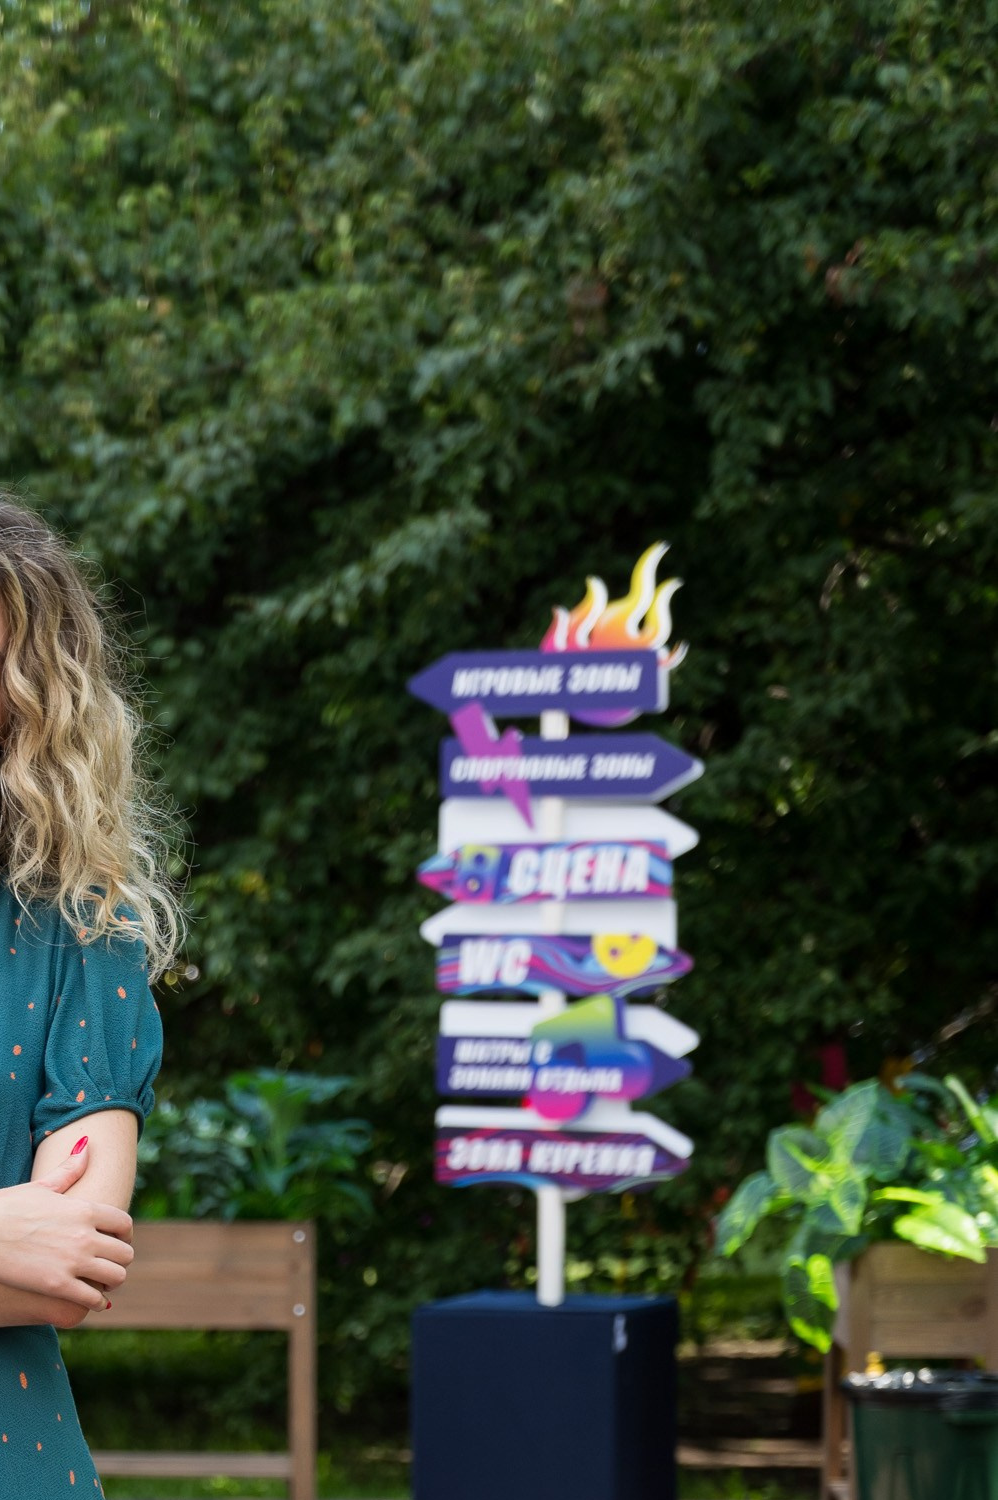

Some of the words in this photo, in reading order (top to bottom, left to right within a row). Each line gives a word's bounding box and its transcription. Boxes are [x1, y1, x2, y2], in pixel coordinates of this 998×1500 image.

[452, 666, 564, 697] ИГРОВЫЕ
[566, 662, 643, 693] ЗОНЫ
[449, 756, 588, 782] СПОРТИВНЫЕ
[589, 753, 656, 780] ЗОНЫ
[508, 845, 650, 900] СЦЕНА
[458, 938, 532, 986] WC
[448, 1065, 534, 1090] ЗОНАМИ
[535, 1066, 623, 1093] ОТДЫХА
[446, 1137, 523, 1171] ЗОНА
[527, 1139, 656, 1177] КУРЕНИЯ
